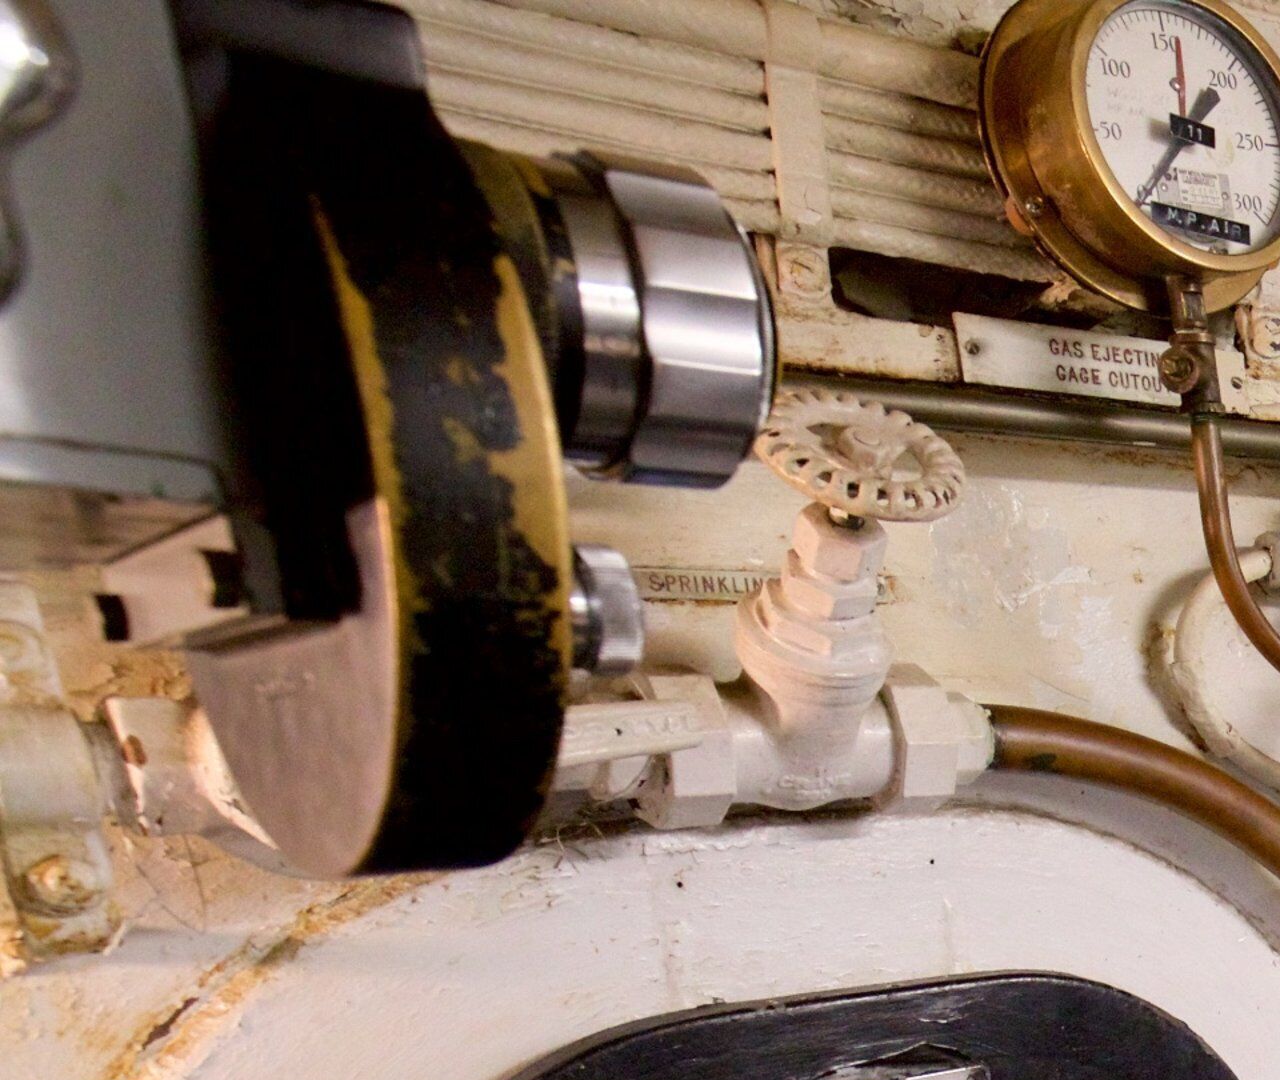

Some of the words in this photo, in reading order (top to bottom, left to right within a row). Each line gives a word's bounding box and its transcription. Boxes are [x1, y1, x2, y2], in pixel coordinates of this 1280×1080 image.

[1100, 57, 1131, 79] 100
[1208, 69, 1238, 90] 200
[1100, 121, 1122, 141] 50
[1235, 132, 1264, 151] 250
[1234, 192, 1262, 212] 300
[1049, 338, 1084, 359] GAS
[1091, 344, 1162, 368] EJECTIN
[1056, 364, 1101, 386] GAGE
[1108, 371, 1171, 393] CUTOU
[648, 574, 764, 595] SPRINKLIN
